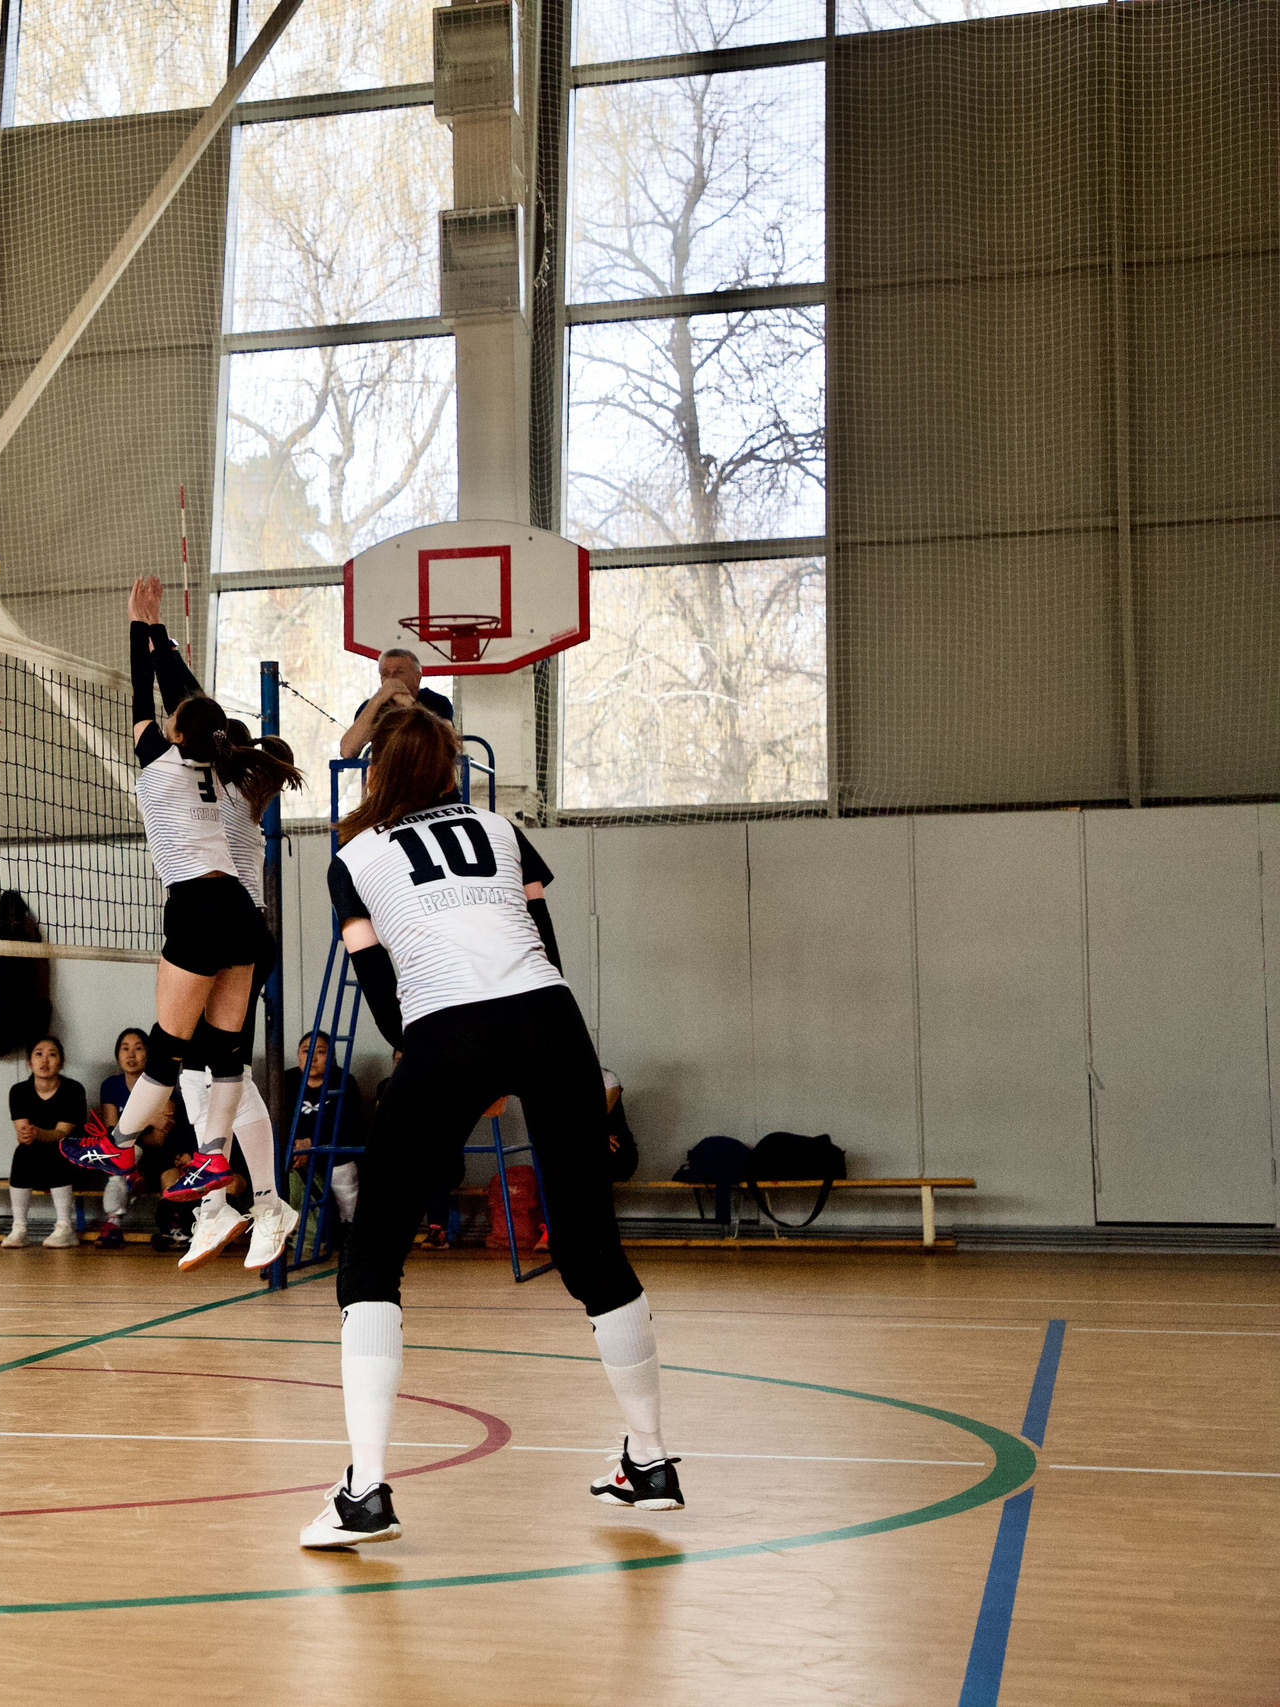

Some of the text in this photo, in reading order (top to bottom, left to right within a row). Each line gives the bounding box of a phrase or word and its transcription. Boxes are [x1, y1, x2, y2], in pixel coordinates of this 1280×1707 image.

[194, 766, 218, 803] 3
[388, 817, 497, 886] 10
[418, 887, 461, 916] B2B
